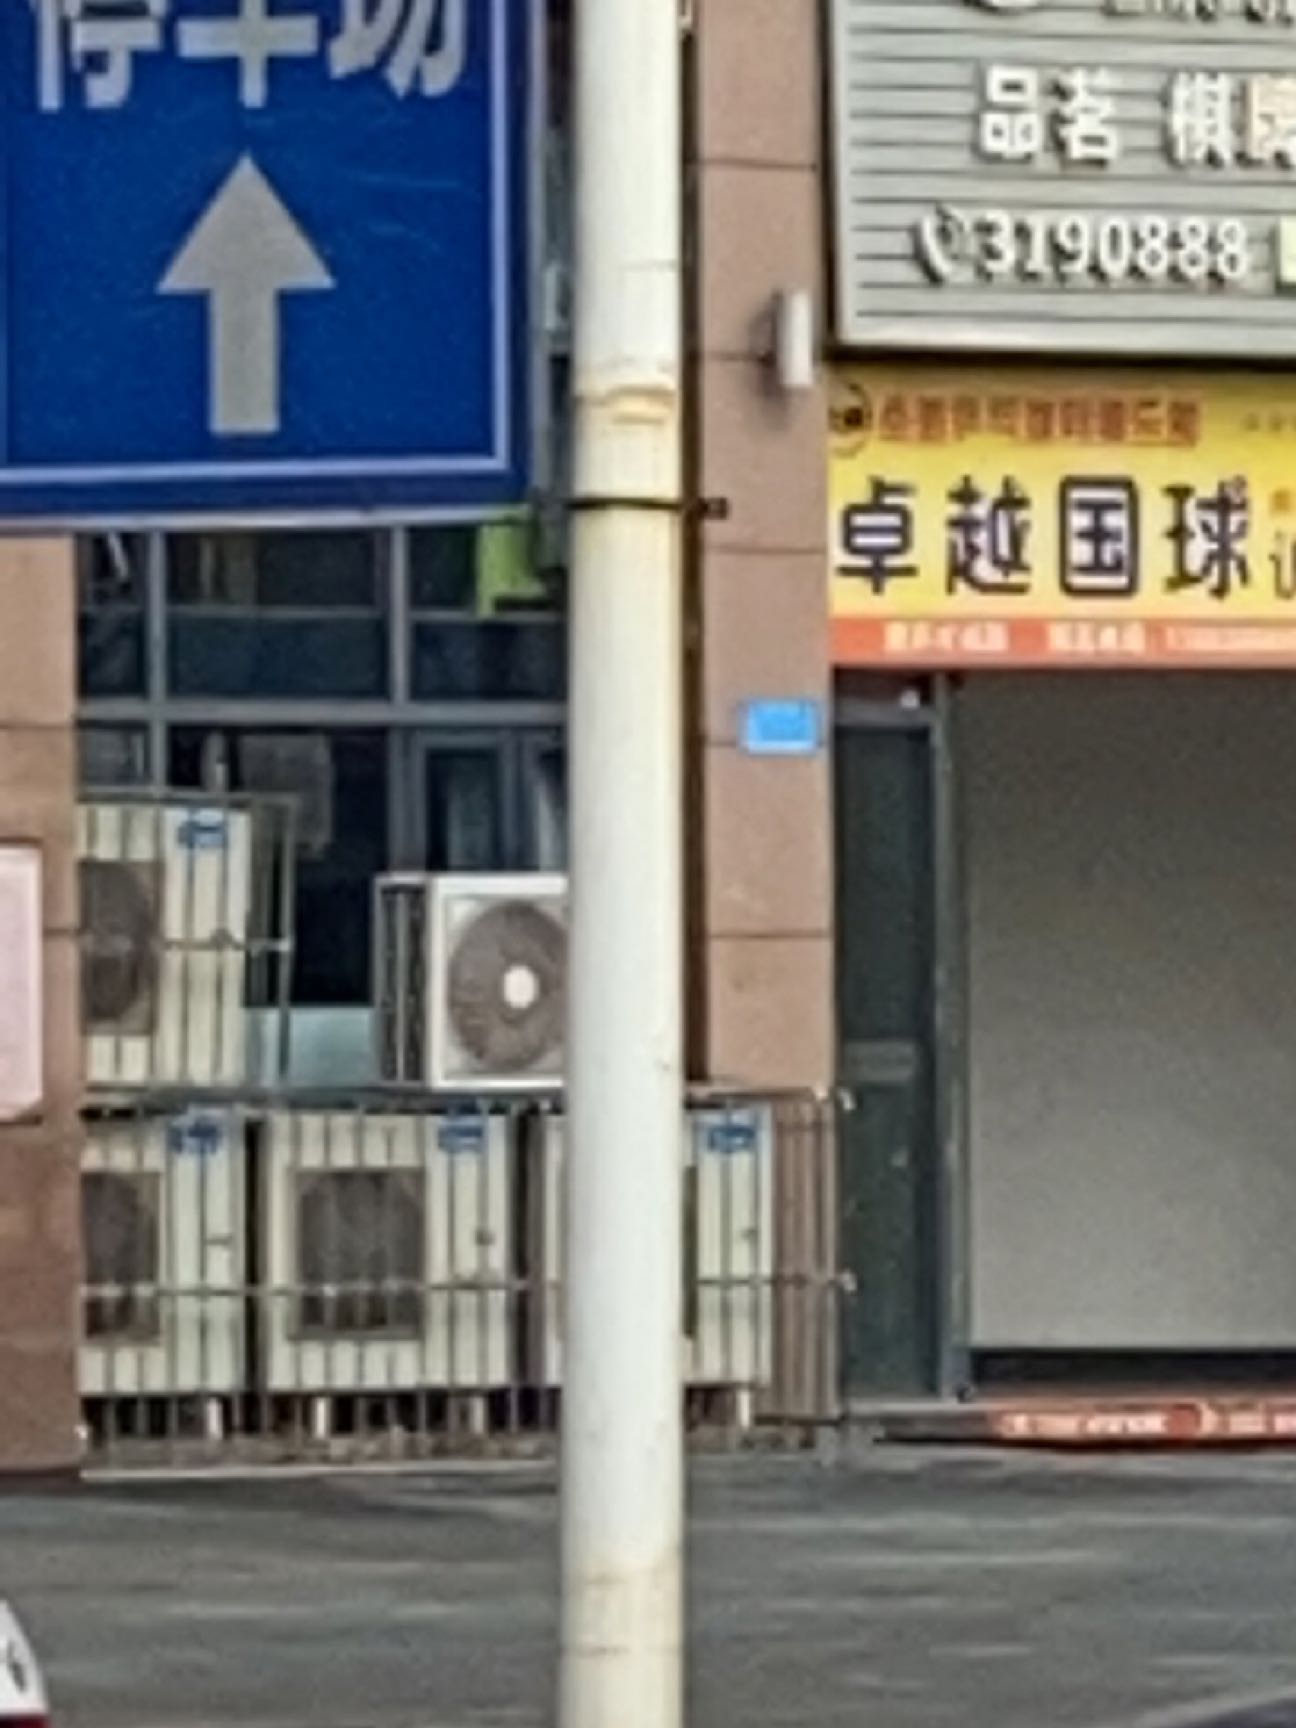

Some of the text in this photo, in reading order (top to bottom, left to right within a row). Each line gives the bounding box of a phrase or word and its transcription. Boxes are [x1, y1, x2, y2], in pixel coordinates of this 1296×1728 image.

[977, 208, 1250, 280] 3190888
[835, 474, 1252, 600] 卓越国球
